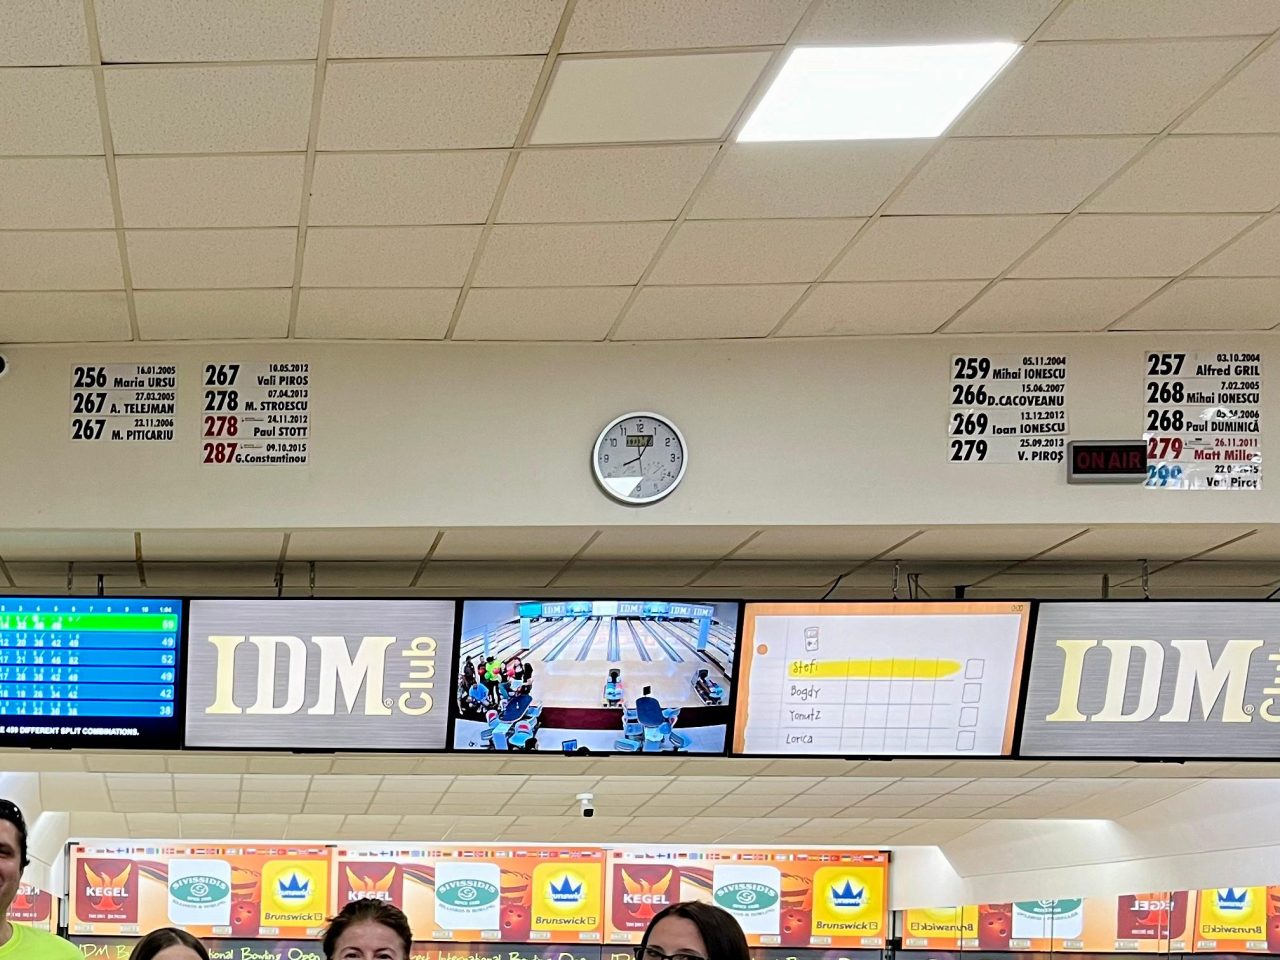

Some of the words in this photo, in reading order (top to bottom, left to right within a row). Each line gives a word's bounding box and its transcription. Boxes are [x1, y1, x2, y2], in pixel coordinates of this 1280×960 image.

[1023, 357, 1066, 365] 05.11.2004
[1217, 354, 1260, 362] 03.10.2004
[137, 366, 176, 374] 16.01.2005
[269, 364, 309, 372] 10.05.2012
[955, 358, 991, 379] 259
[1148, 354, 1186, 375] 257
[205, 365, 240, 386] 267
[993, 368, 1021, 379] Mihai
[1025, 369, 1066, 379] IONESCU
[1196, 365, 1231, 376] Alfred
[1235, 366, 1260, 376] GRIL
[74, 367, 107, 388] 256
[114, 377, 144, 388] Maria
[148, 378, 175, 388] URSU
[258, 376, 276, 386] Vali
[279, 376, 309, 386] PIROS
[1022, 384, 1065, 392] 15.06.2007
[1221, 381, 1260, 390] 7.02.2005
[135, 393, 175, 401] 27.03.2005
[268, 390, 308, 398] 07.04.2013
[952, 384, 987, 405] 266
[1147, 382, 1185, 403] 268
[73, 393, 107, 413] 267
[205, 390, 239, 411] 278
[988, 396, 1064, 406] D.CACOVEANU
[1187, 393, 1215, 404] Mihai
[1218, 393, 1260, 404] IONESCU
[110, 404, 121, 414] A.
[124, 404, 175, 414] TELEJMAN
[245, 402, 257, 411] M.
[260, 402, 308, 411] STROESCU
[267, 415, 308, 423] 24.11.2012
[1021, 411, 1065, 420] 13.12.2012
[1147, 410, 1184, 431] 268
[72, 419, 106, 440] 267
[204, 416, 238, 437] 278
[952, 413, 988, 435] 269
[993, 425, 1017, 434] Ioan
[1020, 423, 1065, 434] IONESCU
[1186, 421, 1208, 432] Paul
[1211, 420, 1260, 432] DUMINICĂ
[112, 430, 124, 440] M.
[127, 430, 173, 440] PITICARIU
[254, 426, 276, 437] Paul
[279, 427, 308, 437] STOTT
[266, 444, 307, 452] 09.10.2015
[1020, 439, 1064, 447] 25.09.2013
[1215, 438, 1259, 447] 26.11.2011
[204, 443, 238, 463] 287
[951, 440, 987, 461] 279
[1148, 438, 1183, 459] 279
[235, 453, 307, 463] G.Constantinou
[1018, 451, 1029, 461] V.
[1077, 453, 1105, 470] ON
[1107, 451, 1142, 468] AIR
[1194, 450, 1221, 461] Matt
[205, 635, 397, 715] IDM
[398, 635, 438, 716] Club
[1045, 639, 1265, 722] IDM
[786, 733, 813, 745] Lorica
[172, 876, 226, 890] SIVISSIDIS
[439, 880, 496, 893] SIVISSIDIS
[86, 887, 129, 897] KEGEL
[348, 891, 393, 900] KEGEL
[716, 883, 776, 897] SIVISSIDIS
[623, 893, 670, 904] KEGEL
[265, 912, 313, 921] Brunswick
[535, 916, 586, 925] Brunswick
[816, 921, 868, 930] Brunswick
